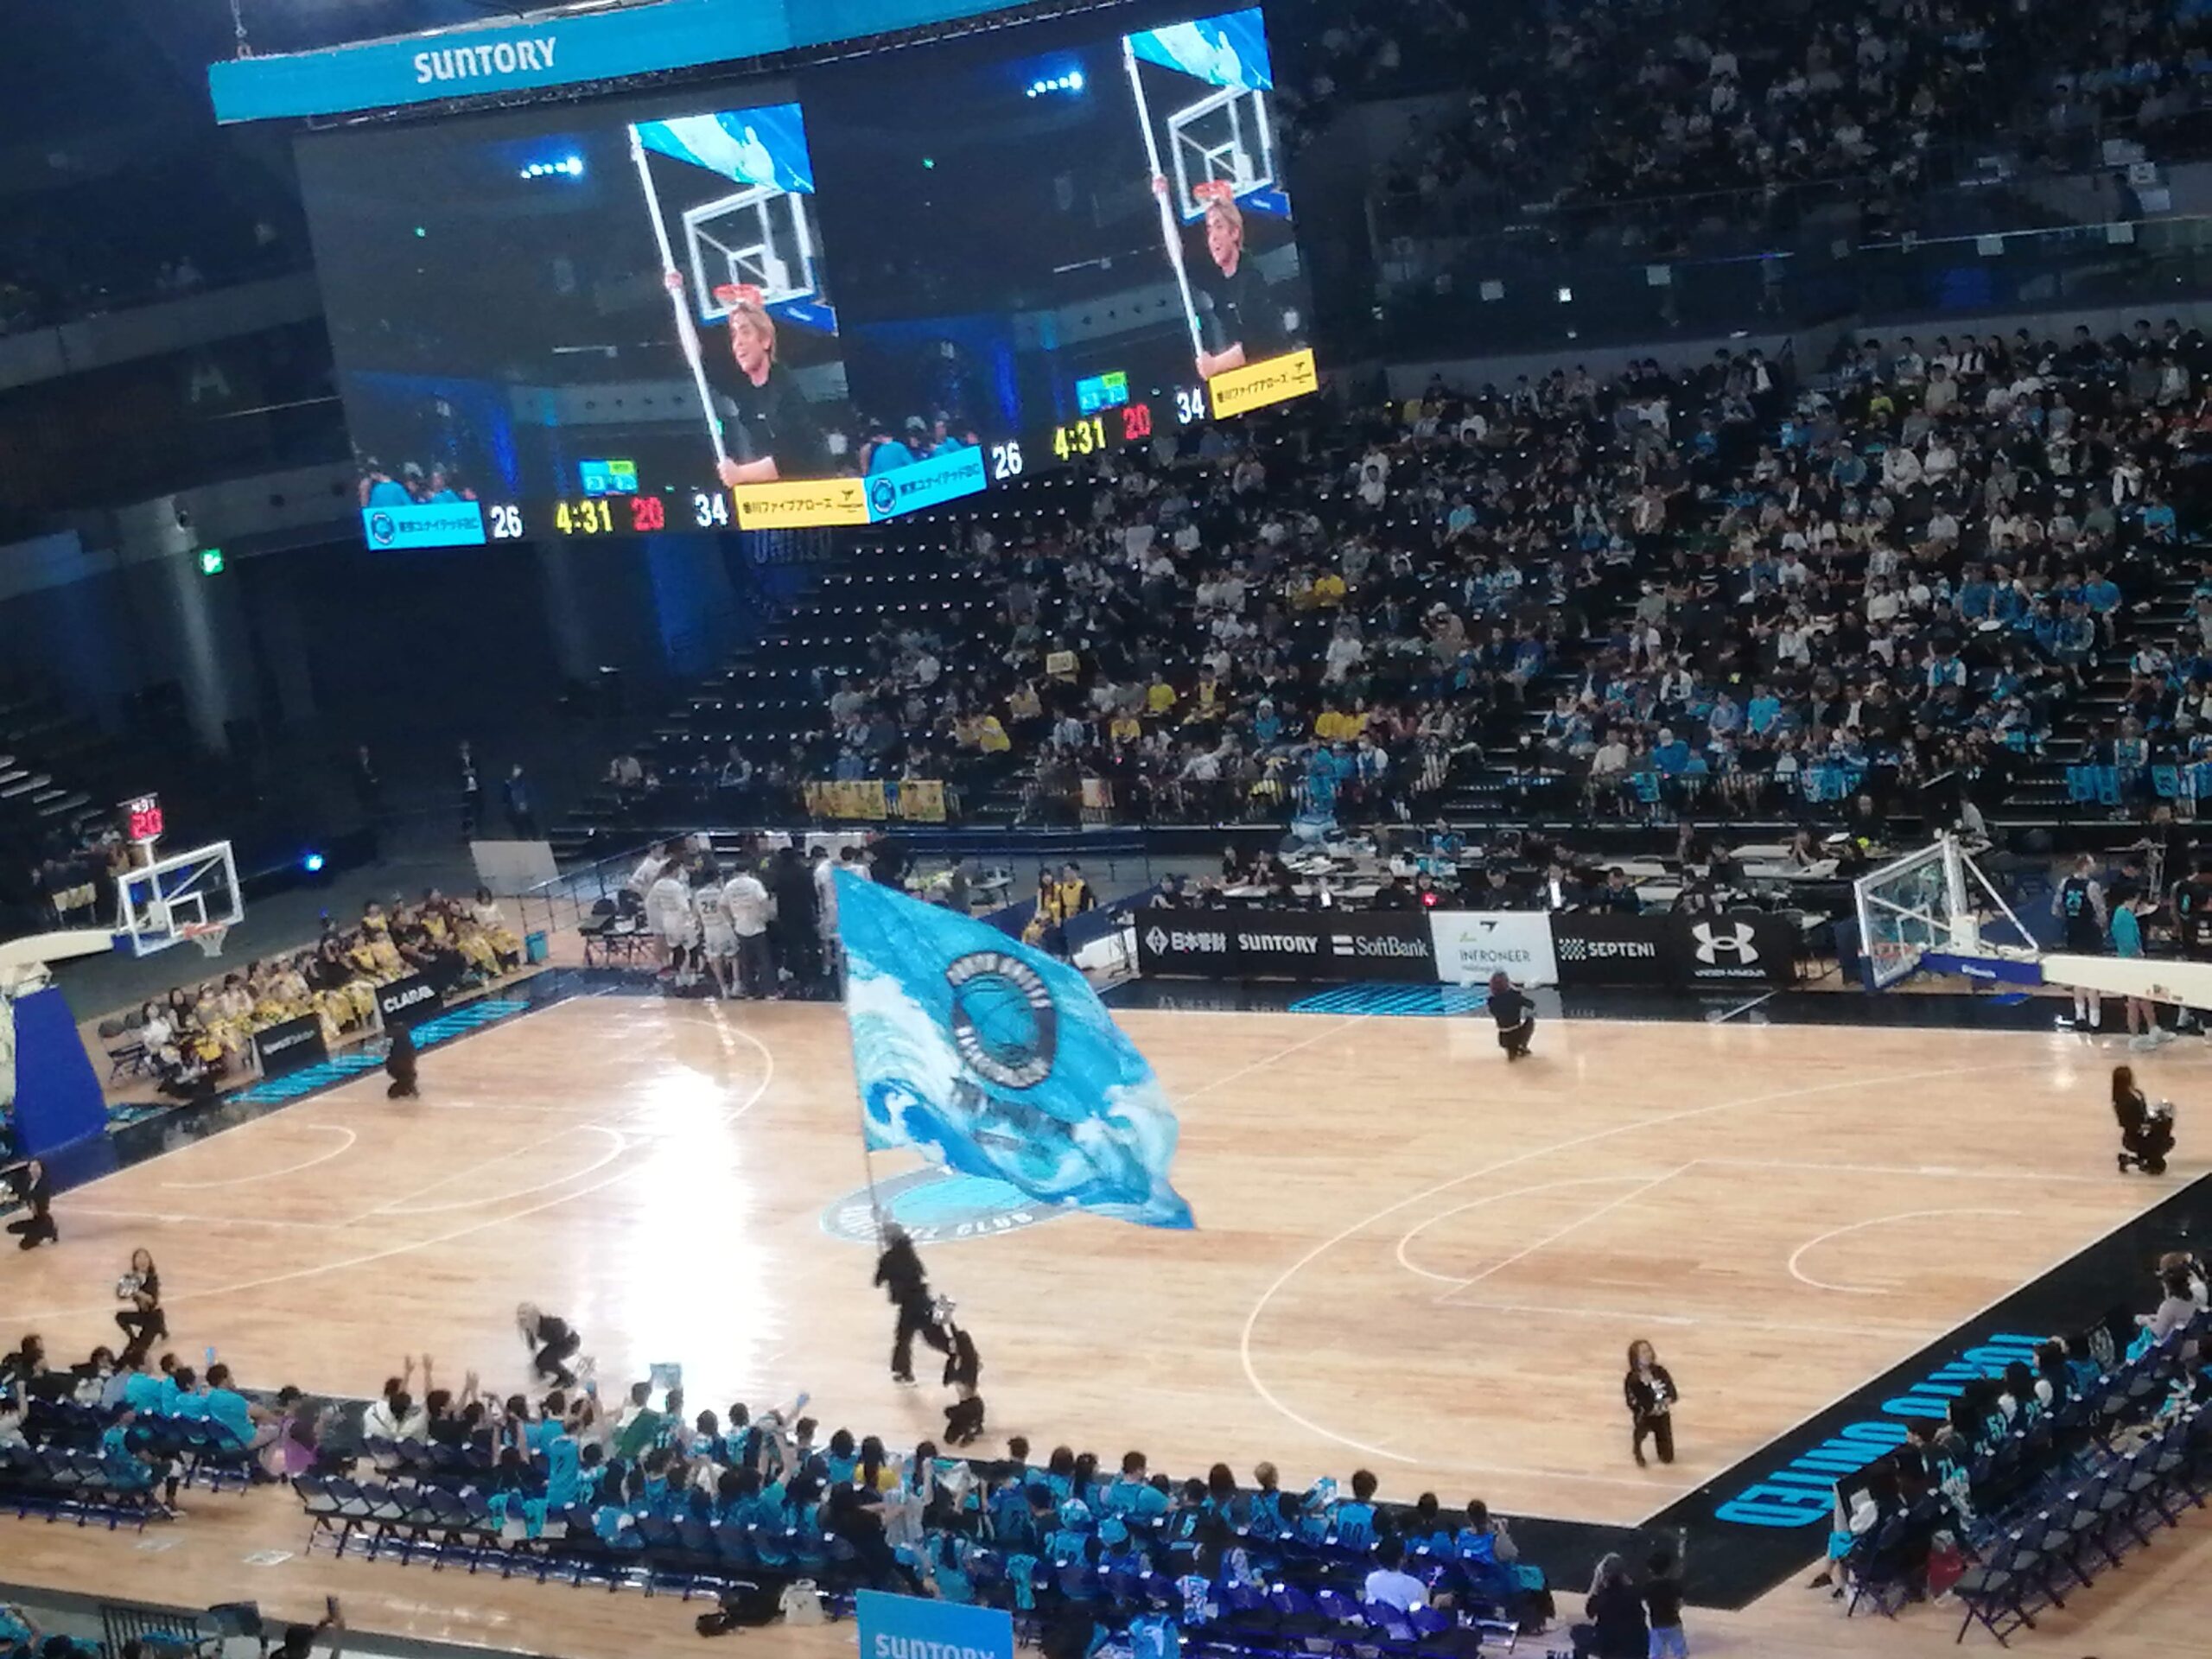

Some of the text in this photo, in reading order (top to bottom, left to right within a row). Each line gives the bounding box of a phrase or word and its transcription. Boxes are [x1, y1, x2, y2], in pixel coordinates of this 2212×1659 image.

[414, 36, 556, 84] SUNTORY
[1122, 404, 1152, 441] 20
[1176, 387, 1205, 424] 34
[1053, 417, 1106, 461] 4:31
[993, 440, 1023, 480] 26
[491, 505, 523, 537] 26
[556, 500, 613, 535] 4:31
[631, 496, 664, 531] 20
[694, 493, 728, 527] 34
[130, 809, 162, 840] 20
[1238, 933, 1319, 954] SUNTORY
[1354, 935, 1429, 957] SoftBank
[1459, 950, 1531, 963] INFRONEER
[1588, 941, 1655, 958] SEPTENI
